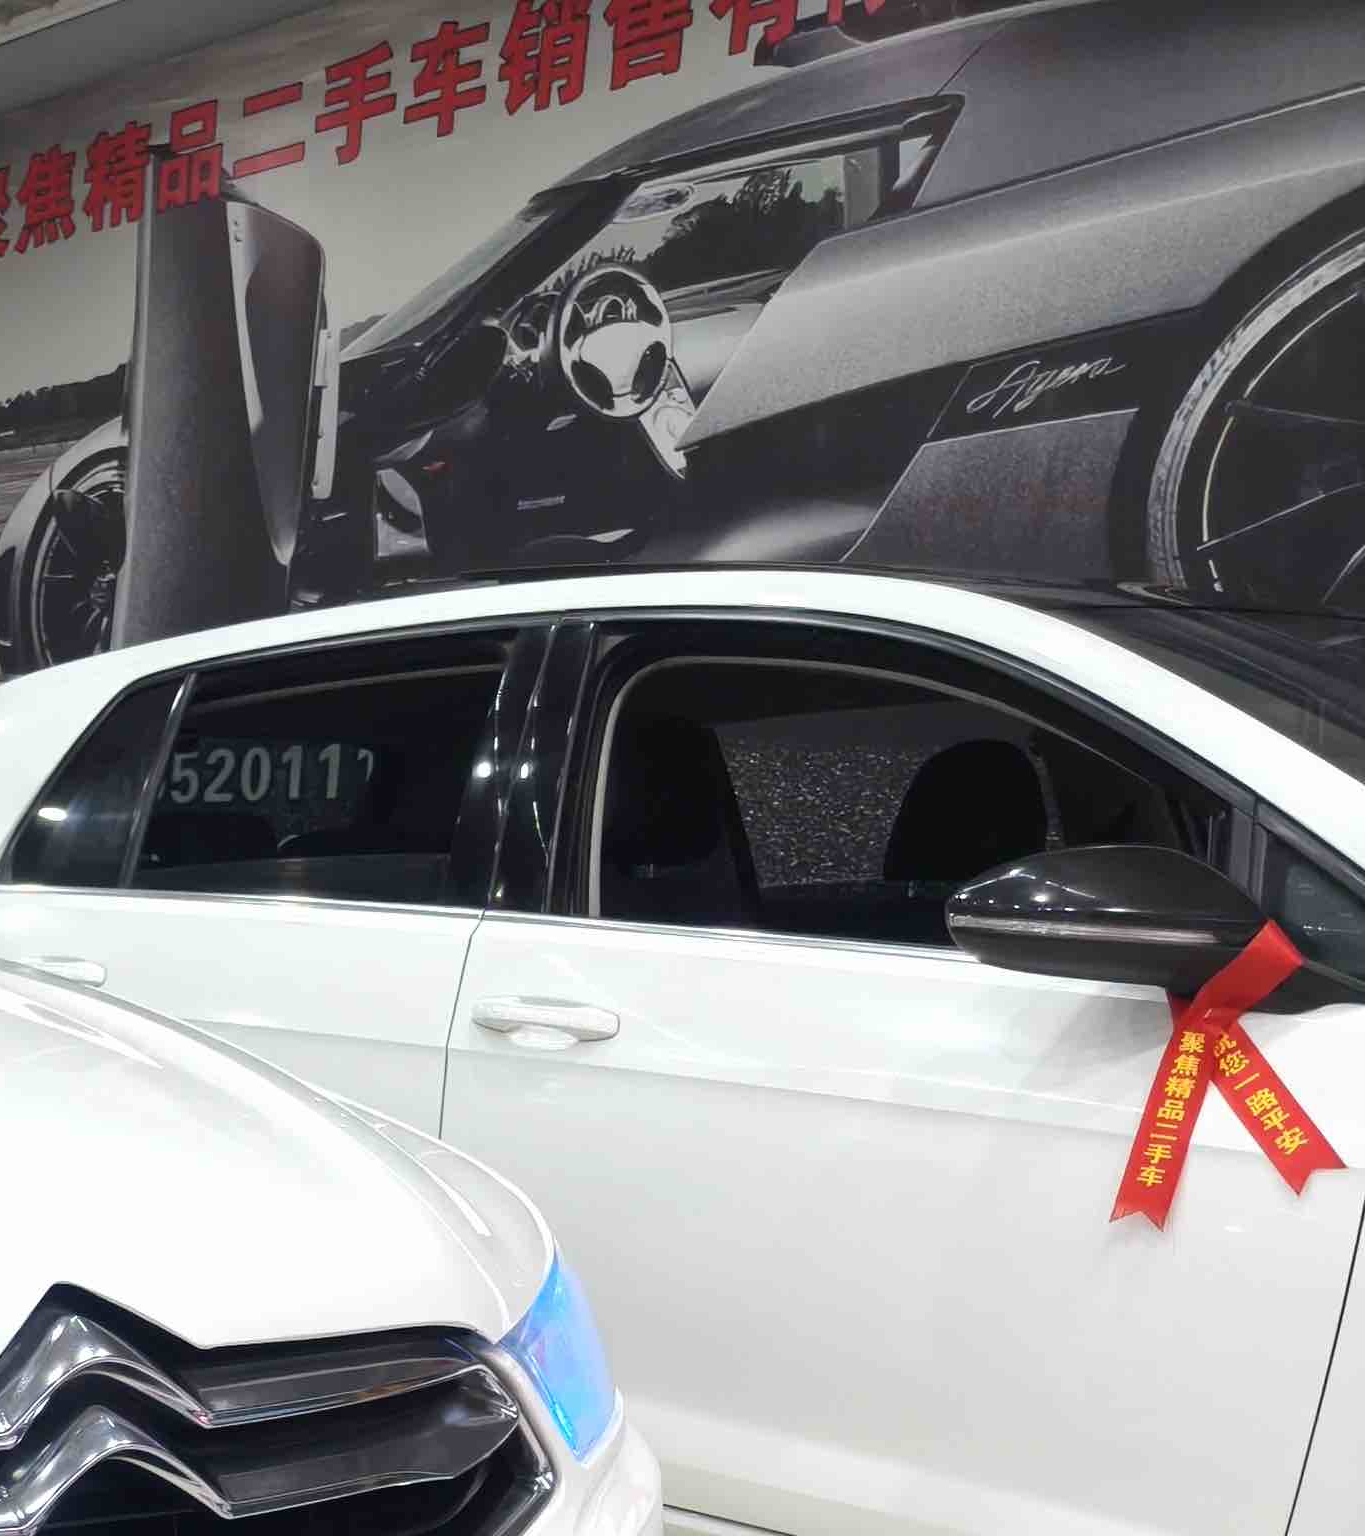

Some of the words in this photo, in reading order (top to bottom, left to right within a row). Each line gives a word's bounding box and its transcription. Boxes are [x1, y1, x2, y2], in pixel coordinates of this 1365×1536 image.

[1136, 1031, 1205, 1187] 聚焦精品二手车
